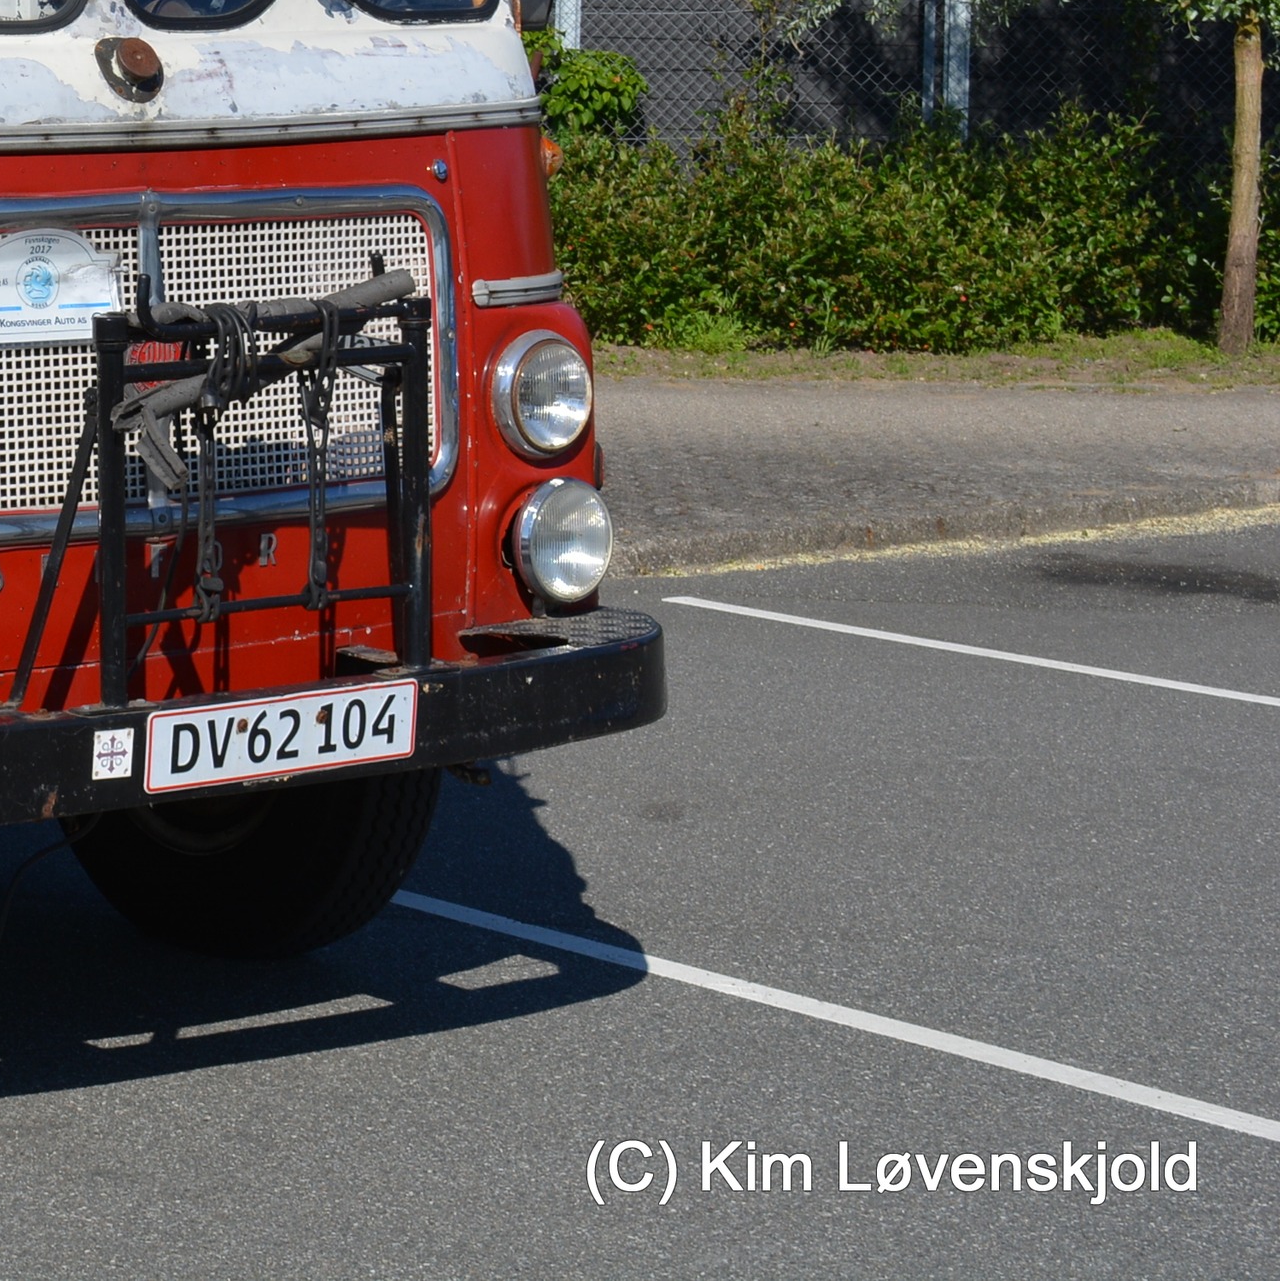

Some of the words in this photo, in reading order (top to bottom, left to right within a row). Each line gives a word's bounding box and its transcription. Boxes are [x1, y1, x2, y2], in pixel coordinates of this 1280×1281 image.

[29, 245, 52, 255] 2017
[171, 717, 235, 774] DV
[247, 709, 301, 764] 62
[318, 694, 396, 754] 104
